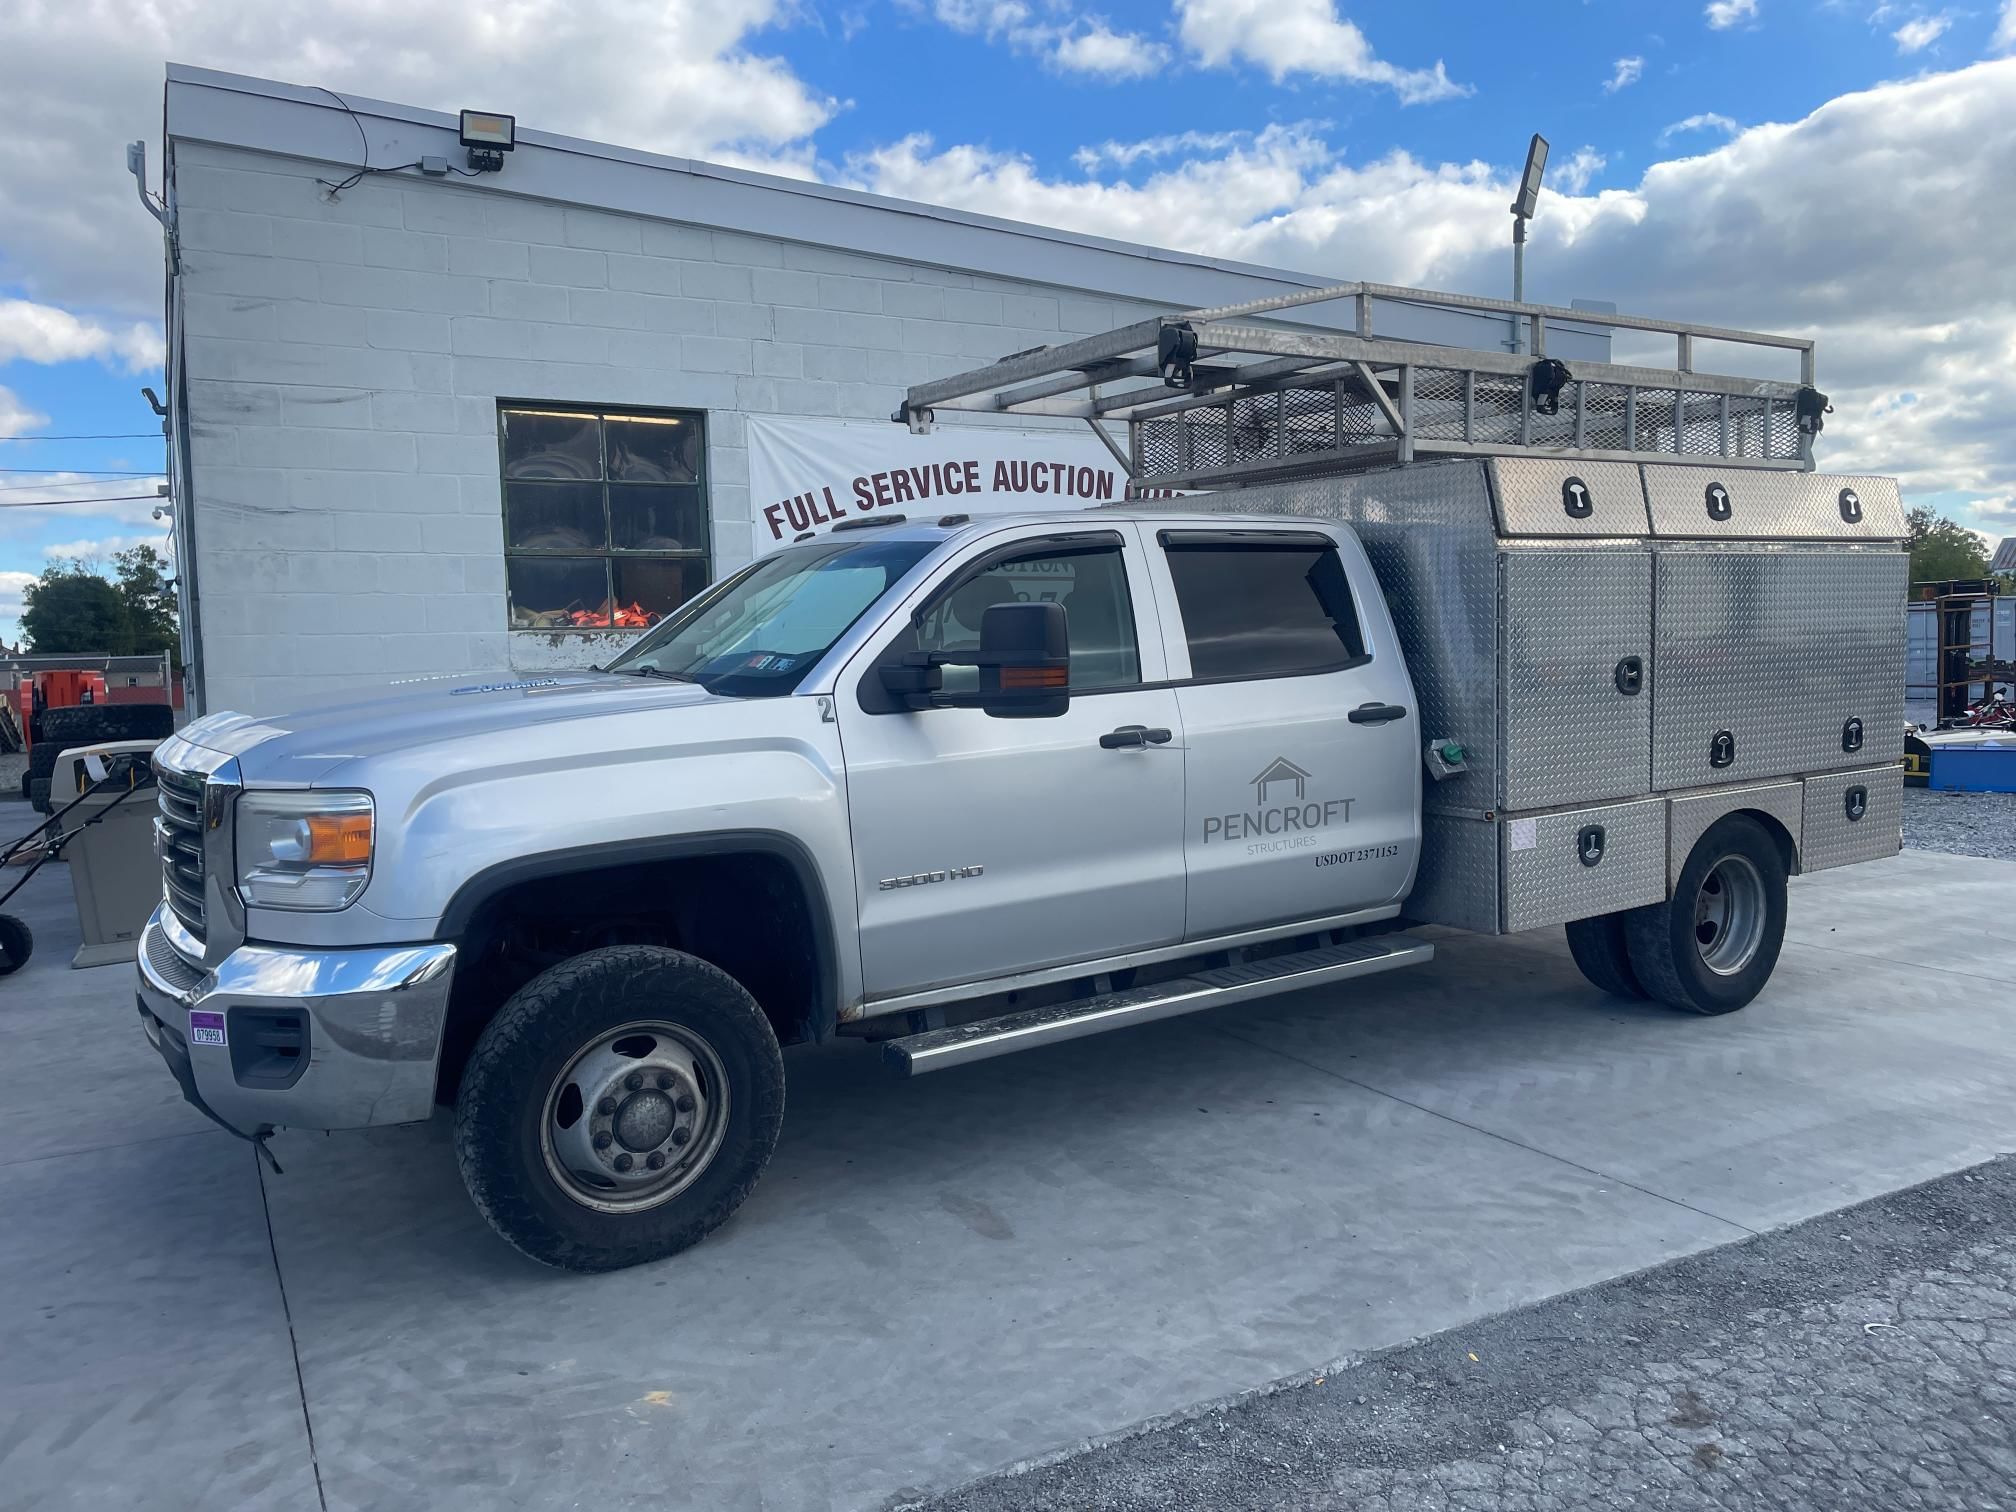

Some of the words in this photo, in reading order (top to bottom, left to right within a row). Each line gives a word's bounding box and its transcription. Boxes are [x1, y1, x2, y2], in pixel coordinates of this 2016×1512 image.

[763, 486, 847, 540] FULL
[852, 460, 982, 511] SERVICE
[993, 460, 1114, 500] AUCTION
[817, 696, 836, 723] 2
[1203, 798, 1356, 844] PENCROFT
[1247, 835, 1317, 856] STRUCTURES
[1315, 850, 1356, 868] USDOT
[1356, 845, 1399, 862] 2371152
[879, 870, 946, 891] 3500
[950, 864, 984, 880] HD
